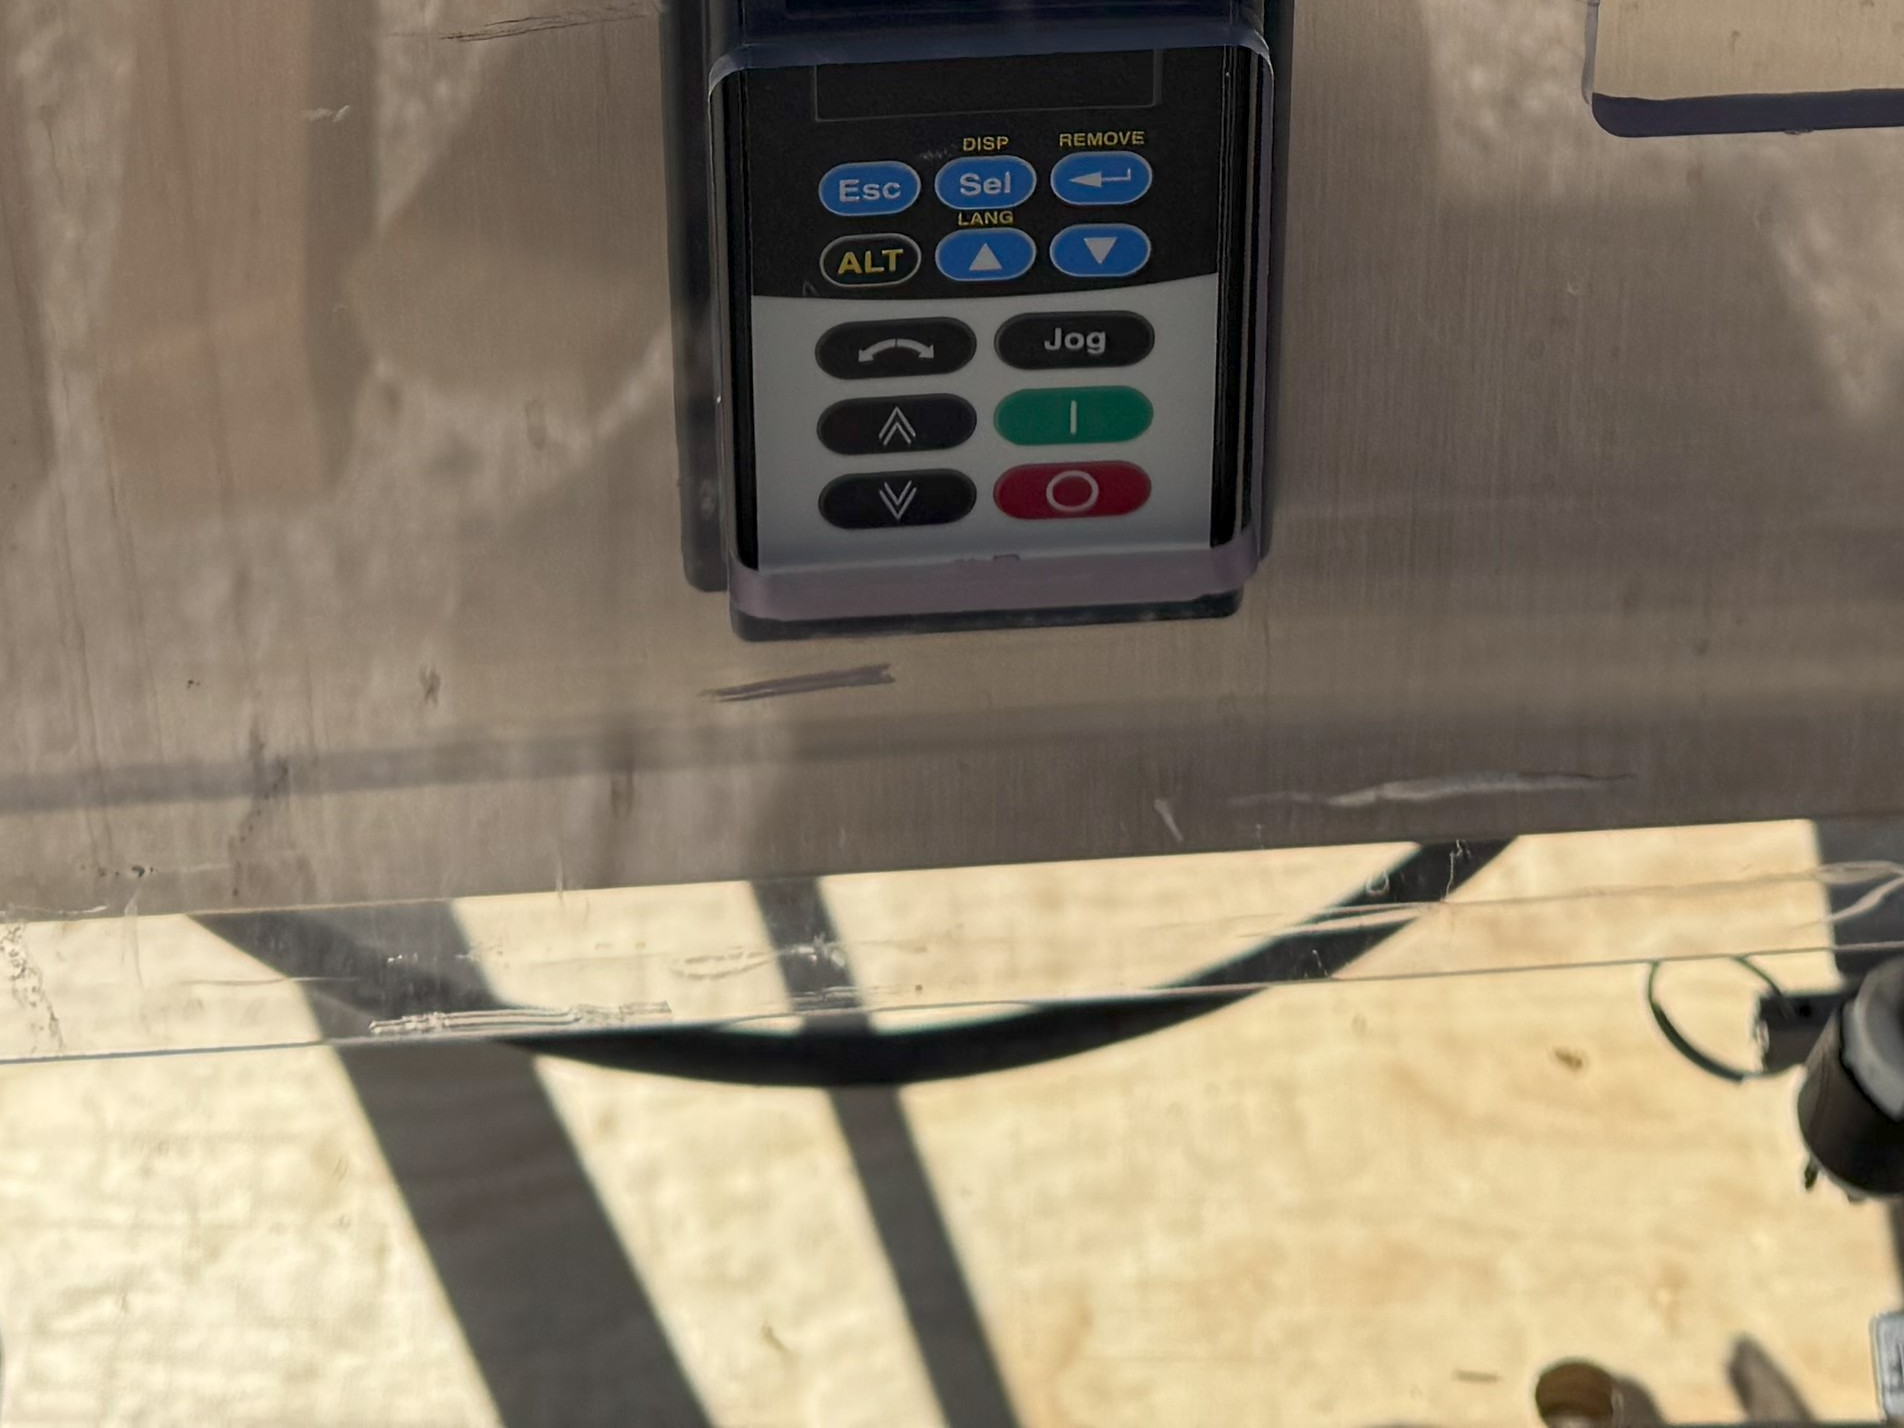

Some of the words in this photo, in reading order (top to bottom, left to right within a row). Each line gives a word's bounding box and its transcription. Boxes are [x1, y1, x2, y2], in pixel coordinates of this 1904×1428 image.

[962, 136, 1009, 151] DISP
[1059, 131, 1145, 148] REMOVE
[838, 178, 902, 203] Esc
[959, 171, 1012, 196] Sel
[957, 210, 1014, 226] LANG
[837, 249, 903, 276] ALT
[1044, 326, 1107, 355] Jog
